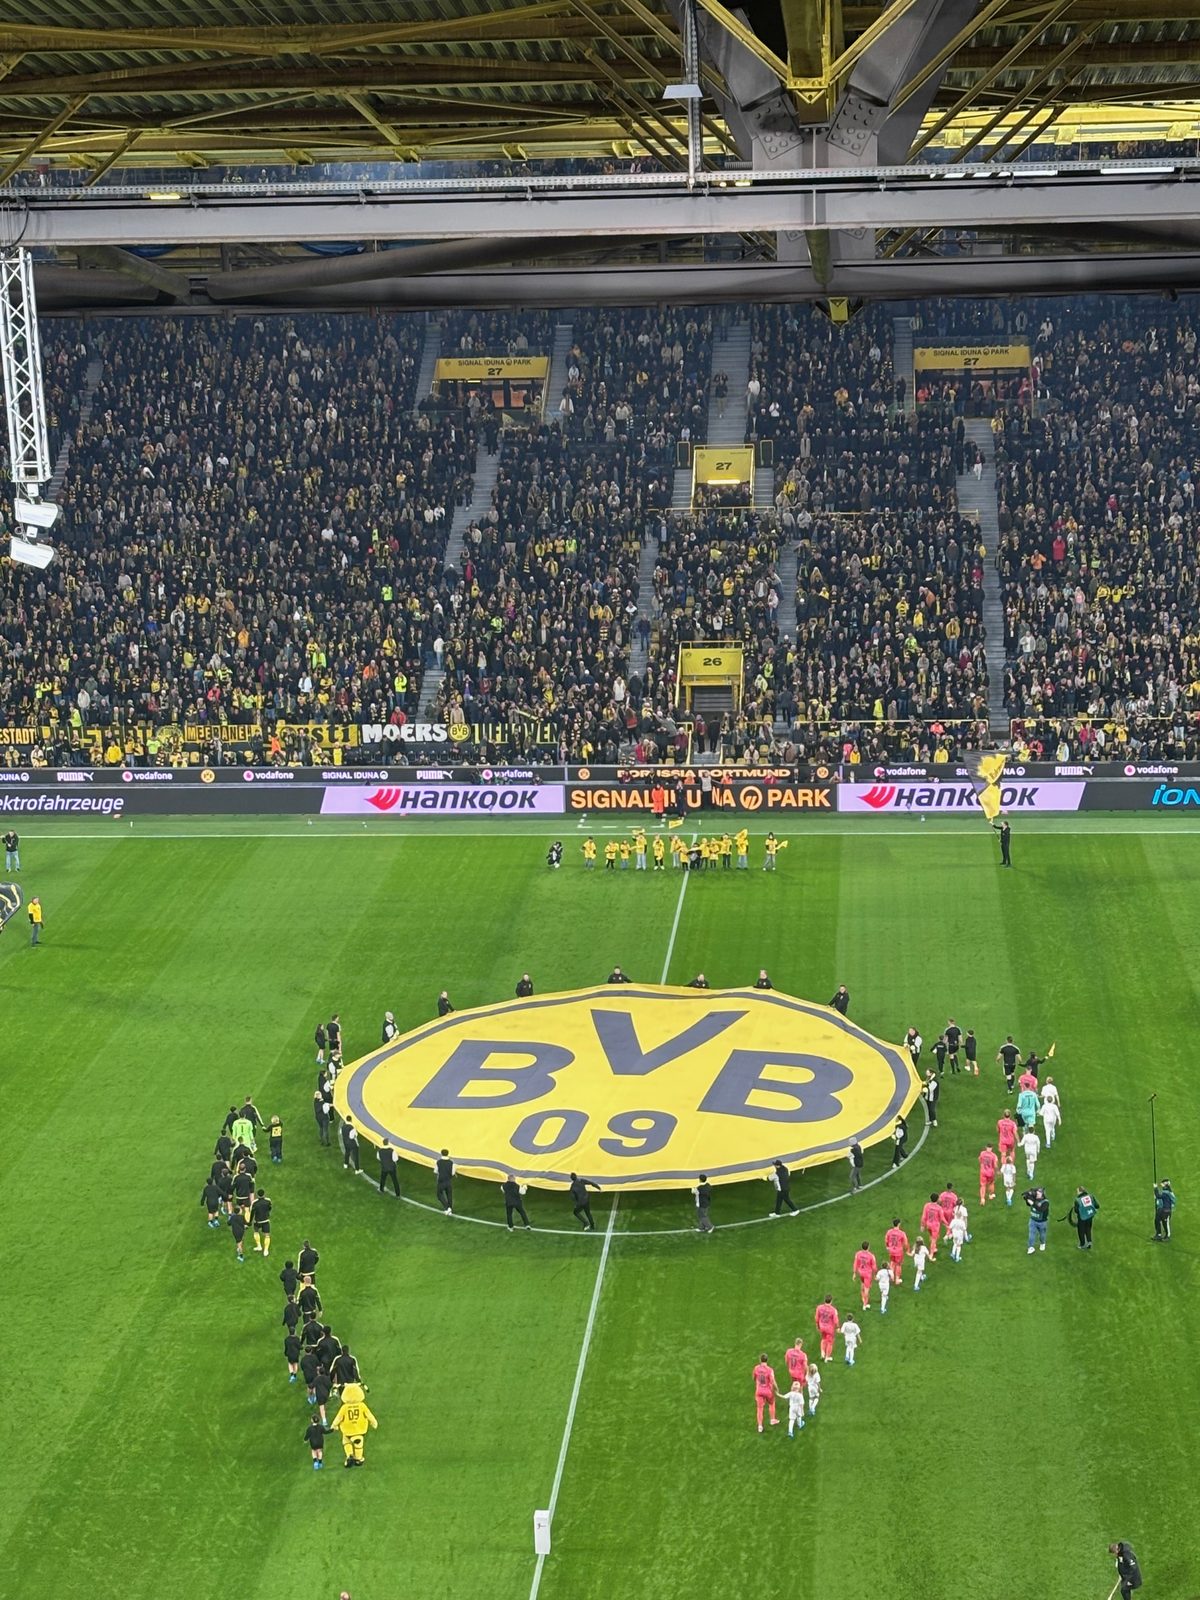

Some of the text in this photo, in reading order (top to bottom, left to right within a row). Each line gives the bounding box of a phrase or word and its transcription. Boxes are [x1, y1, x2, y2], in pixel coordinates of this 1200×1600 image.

[963, 358, 979, 366] 27
[488, 368, 502, 376] 27
[715, 462, 732, 470] 27
[703, 657, 722, 666] 26
[362, 723, 448, 743] MOERS
[886, 767, 927, 775] vodafone
[1055, 766, 1084, 776] PUMA
[1137, 765, 1179, 774] vodafone
[57, 772, 85, 781] PUMA
[134, 771, 173, 780] vodafone
[255, 770, 294, 780] vodafone
[322, 771, 379, 779] SIGNAL IDUNA
[416, 770, 445, 779] PUMA
[571, 789, 655, 808] SIGNAL
[767, 789, 831, 807] PARK
[408, 1009, 853, 1123] BVB
[509, 1109, 678, 1157] 09
[348, 1409, 359, 1420] 09
